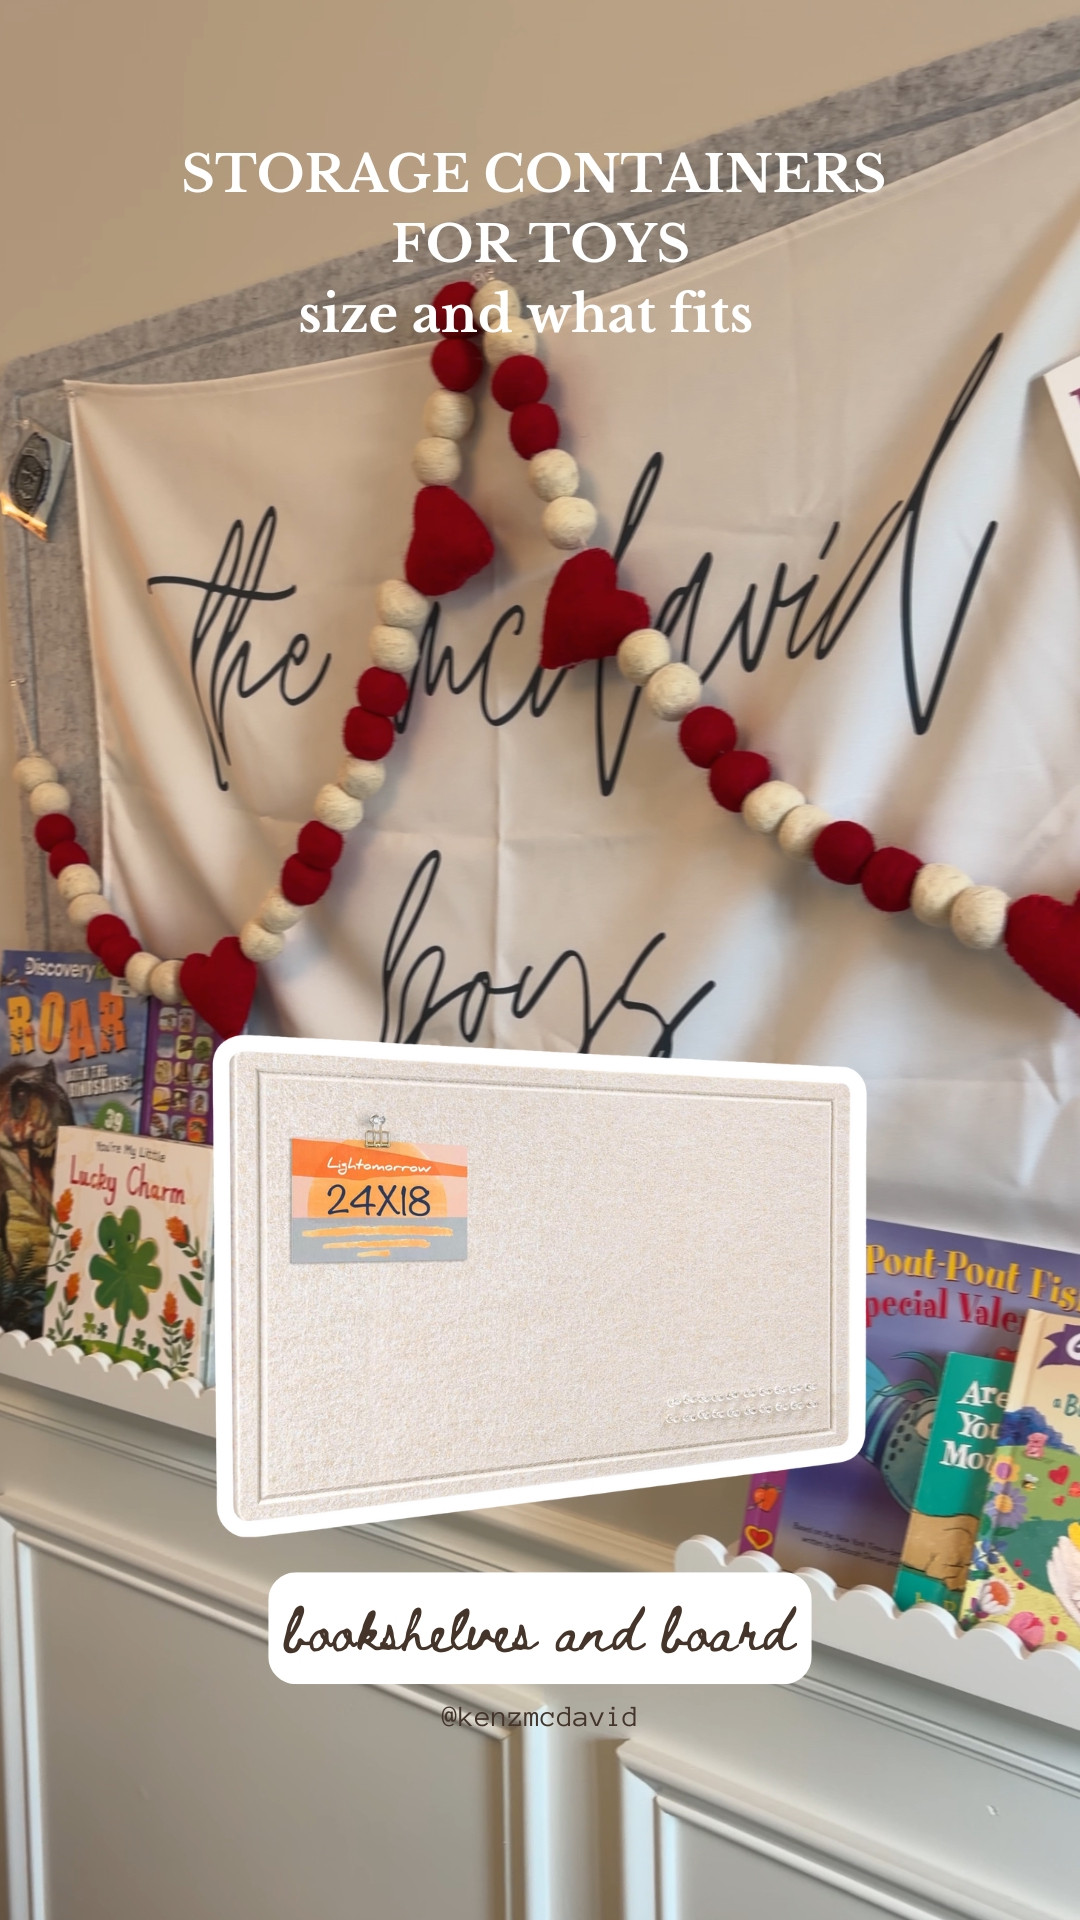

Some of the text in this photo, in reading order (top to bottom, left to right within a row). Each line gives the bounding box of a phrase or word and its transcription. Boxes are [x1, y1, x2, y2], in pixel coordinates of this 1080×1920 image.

[147, 505, 331, 791] the
[25, 956, 96, 984] Discovery
[381, 850, 716, 1057] boys
[8, 992, 127, 1062] ROAR
[95, 1141, 167, 1163] You're My Little
[326, 1156, 432, 1175] Lightomorrow
[70, 1154, 187, 1206] Lucky Charm
[326, 1183, 432, 1217] 24X18
[866, 1244, 1080, 1314] Pout-Pout Fis
[866, 1287, 949, 1329] pecial
[1064, 1393, 1080, 1417] B
